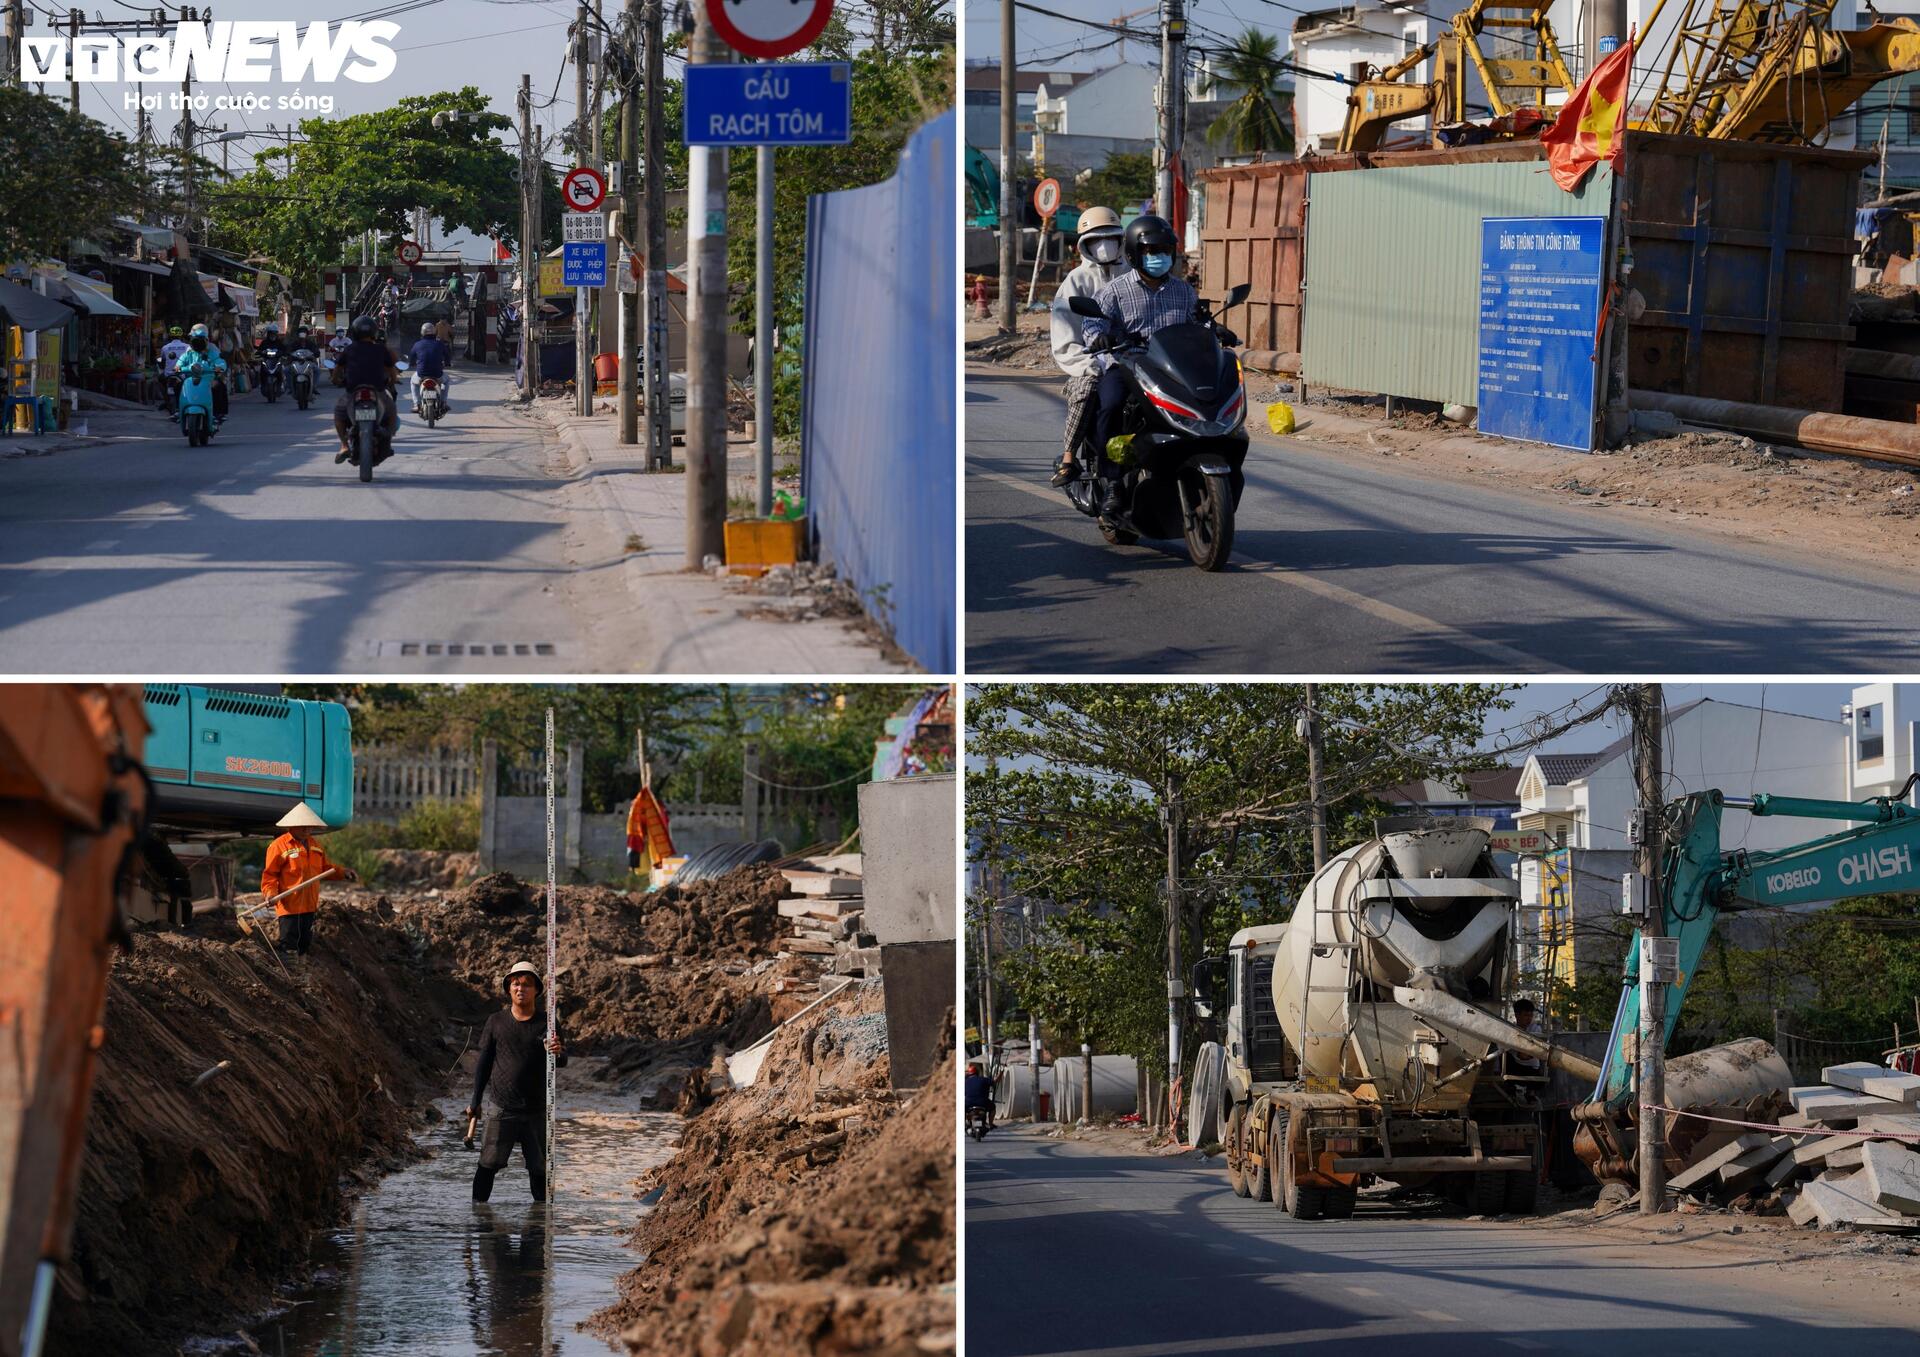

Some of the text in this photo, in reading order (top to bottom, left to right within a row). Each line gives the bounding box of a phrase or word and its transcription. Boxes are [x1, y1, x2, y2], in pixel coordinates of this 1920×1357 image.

[709, 109, 823, 140] RẠCH TÔM
[571, 247, 580, 256] XE
[1516, 232, 1535, 251] THÔNG
[1536, 234, 1545, 251] TIN
[1546, 232, 1562, 251] CÔNG
[1766, 866, 1822, 894] KOBELCO
